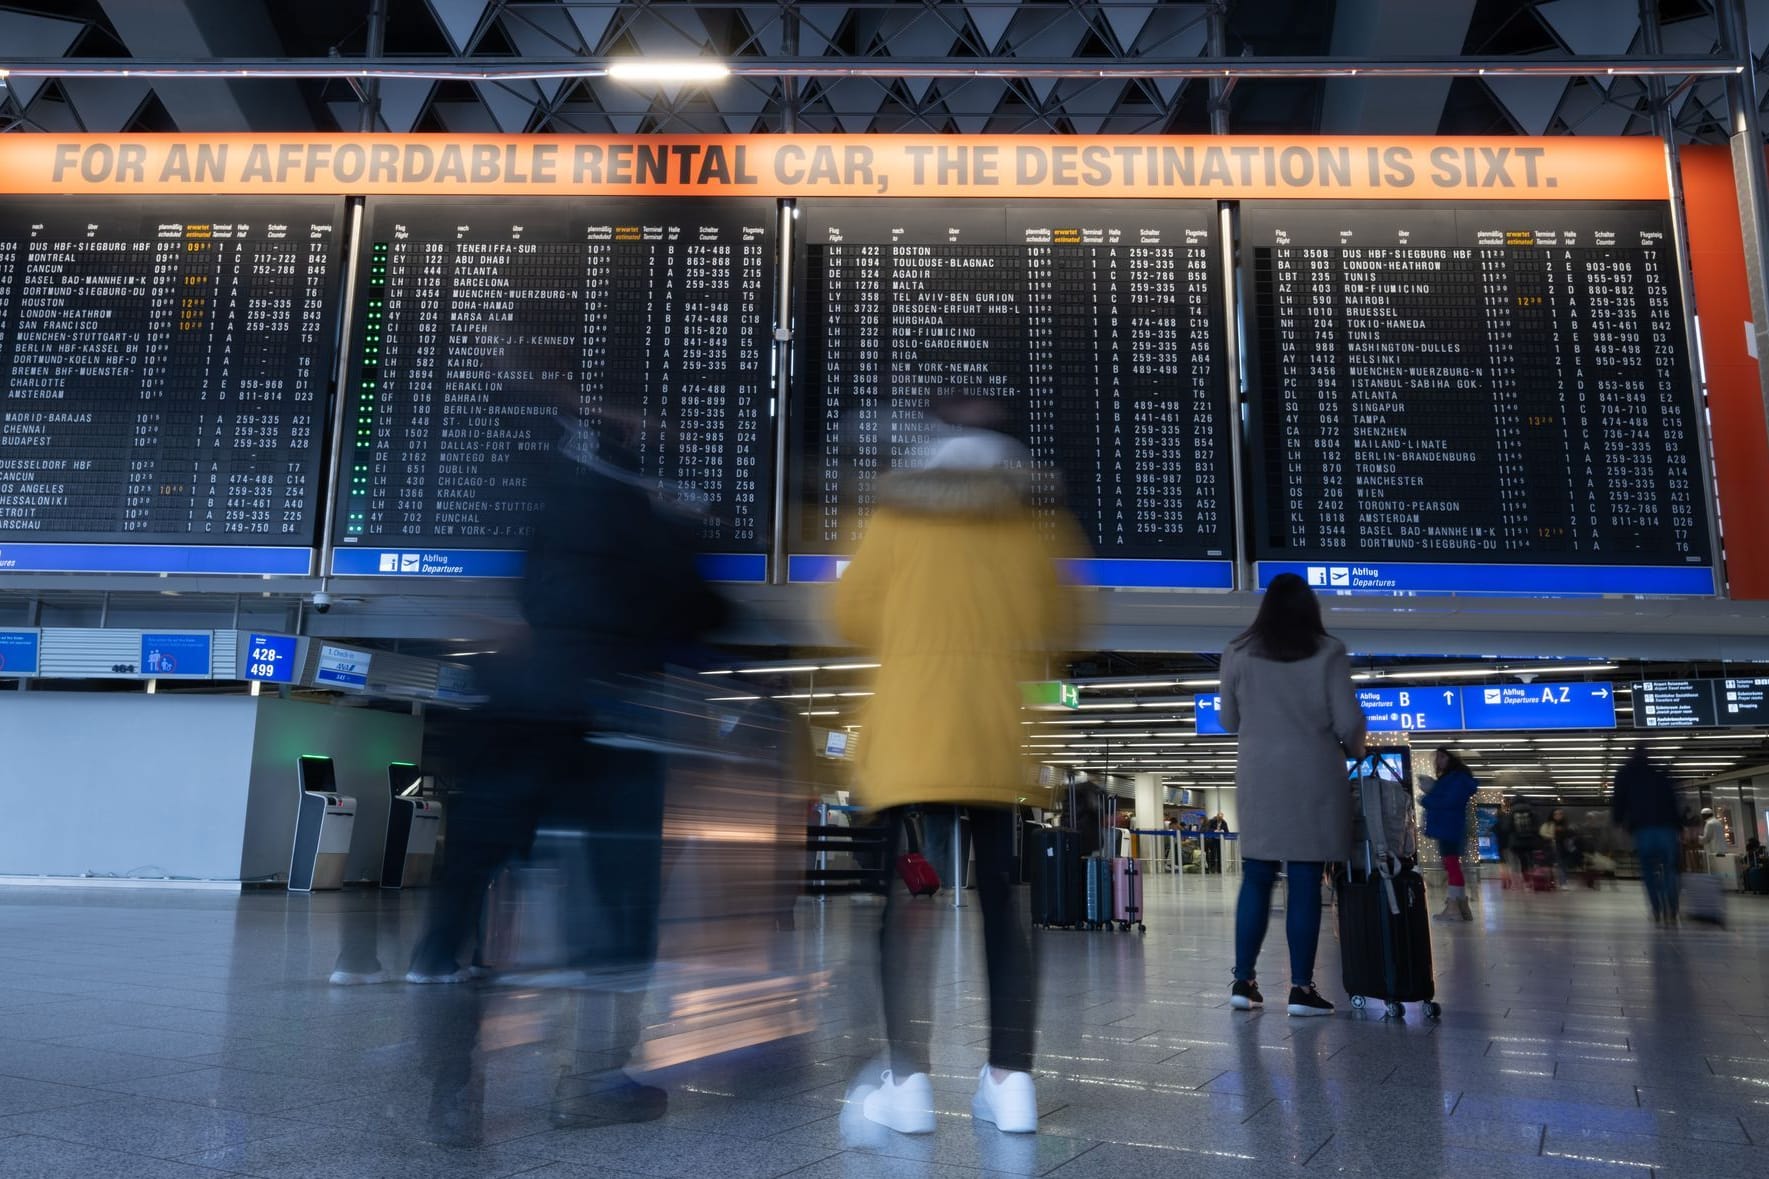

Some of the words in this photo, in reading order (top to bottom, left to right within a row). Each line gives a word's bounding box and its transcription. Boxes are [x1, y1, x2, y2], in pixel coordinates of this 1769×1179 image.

[51, 144, 146, 183] FOR
[159, 144, 229, 183] AN
[240, 144, 559, 184] AFFORDABLE
[571, 145, 757, 185] RENTAL
[773, 145, 890, 192] CAR,
[905, 146, 999, 186] THE
[1015, 146, 1350, 187] DESTINATION
[1367, 147, 1414, 188] IS
[1430, 147, 1557, 188] SIXT.
[457, 244, 536, 253] TENERIFFA-SUR
[688, 246, 730, 254] 474-488
[894, 247, 930, 255] BOSTON
[1130, 249, 1173, 257] 259-335
[1188, 249, 1205, 257] Z18
[1304, 250, 1328, 258] 3508
[1369, 250, 1446, 258] HBF-SIEGBURG
[894, 258, 994, 267] TOULOUSE-BLAGNAC
[1344, 262, 1440, 270] LONDON-HEATHROW
[1586, 263, 1631, 271] 903-906
[27, 265, 62, 273] CANCUN
[254, 266, 294, 274] 752-786
[455, 267, 497, 275] ATLANTA
[893, 270, 930, 278] AGADIR
[1131, 272, 1174, 280] 752-786
[1344, 273, 1375, 281] TUNIS
[1588, 274, 1632, 282] 955-957
[62, 276, 146, 284] BAD-MANNHEIM-K
[686, 280, 729, 288] 259-335
[24, 287, 145, 296] DORTMUND-SIEGBURG-DU
[1345, 284, 1429, 293] ROM-FIUMICINO
[453, 290, 577, 298] MUENCHEN-WUERZBURG-N
[893, 293, 910, 301] TEL
[918, 293, 968, 301] AVIV-BEN
[1131, 295, 1174, 303] 791-794
[22, 298, 64, 306] HOUSTON
[249, 300, 291, 308] 259-335
[1346, 296, 1388, 304] NAIROBI
[452, 301, 513, 309] DOHA-HAMAD
[893, 305, 980, 313] DRESDEN-ERFURT
[21, 310, 112, 318] LONDON-HEATHROW
[1347, 308, 1397, 316] BRUESSEL
[893, 316, 943, 324] HURGHADA
[19, 321, 36, 329] SAN
[44, 321, 97, 329] FRANCISCO
[452, 324, 487, 332] TAIPEH
[684, 326, 727, 334] 815-820
[1348, 320, 1425, 328] TOKIO-HANEDA
[1592, 321, 1636, 330] 451-461
[17, 332, 139, 341] MUENCHEN-STUTTGART-U
[893, 328, 975, 336] ROM-FIUMICINO
[1348, 332, 1379, 340] TUNIS
[684, 338, 727, 346] 841-849
[892, 340, 988, 348] OSLO-GARDERMOEN
[16, 344, 52, 352] BERLIN
[59, 344, 122, 352] HBF-KASSEL
[449, 348, 504, 356] VANCOUVER
[1348, 343, 1460, 352] WASHINGTON-DULLES
[14, 355, 100, 364] DORTMUND-KOELN
[892, 351, 917, 359] RIGA
[1349, 355, 1399, 363] HELSINKI
[1596, 357, 1641, 366] 950-952
[919, 363, 988, 372] YORK-NEWARK
[1133, 366, 1177, 374] 489-498
[1350, 367, 1482, 376] MUENCHEN-WUERZBURG-N
[11, 378, 64, 387] CHARLOTTE
[241, 380, 282, 388] 958-968
[446, 382, 502, 390] HERAKLION
[1352, 379, 1449, 388] ISTANBUL-SABIHA
[8, 390, 64, 398] AMSTERDAM
[239, 392, 281, 400] 811-814
[445, 394, 488, 402] BAHRAIN
[682, 396, 725, 405] 896-899
[892, 399, 929, 407] DENVER
[444, 406, 558, 415] BERLIN-BRANDENBURG
[1353, 403, 1404, 412] SINGAPUR
[1602, 405, 1646, 414] 704-710
[6, 413, 91, 422] MADRID-BARAJAS
[892, 411, 923, 419] ATHEN
[1135, 414, 1178, 422] 441-461
[469, 418, 499, 426] LOUIS
[4, 425, 45, 433] CHENNAI
[442, 429, 530, 438] MADRID-BARAJAS
[1354, 427, 1406, 436] SHENZHEN
[2, 437, 50, 445] BUDAPEST
[1354, 440, 1447, 448] MAILAND-LINATE
[439, 465, 477, 474] DUBLIN
[230, 475, 273, 484] 474-488
[287, 475, 304, 484] C14
[1136, 474, 1181, 483] 986-987
[1357, 476, 1423, 485] MANCHESTER
[20, 484, 64, 493] ANGELES
[1358, 489, 1384, 497] WIEN
[1359, 501, 1459, 511] TORONTO-PEARSON
[436, 513, 479, 522] FUNCHAL
[1360, 514, 1419, 522] AMSTERDAM
[1361, 538, 1496, 549] DORTMUND-SIEGBURG-DU
[423, 555, 448, 563] Abflug
[422, 565, 463, 573] Departures
[1352, 568, 1378, 576] Abflug
[1353, 578, 1395, 587] Departures
[252, 648, 283, 662] 428-
[251, 663, 274, 677] 499
[1400, 692, 1409, 706] B
